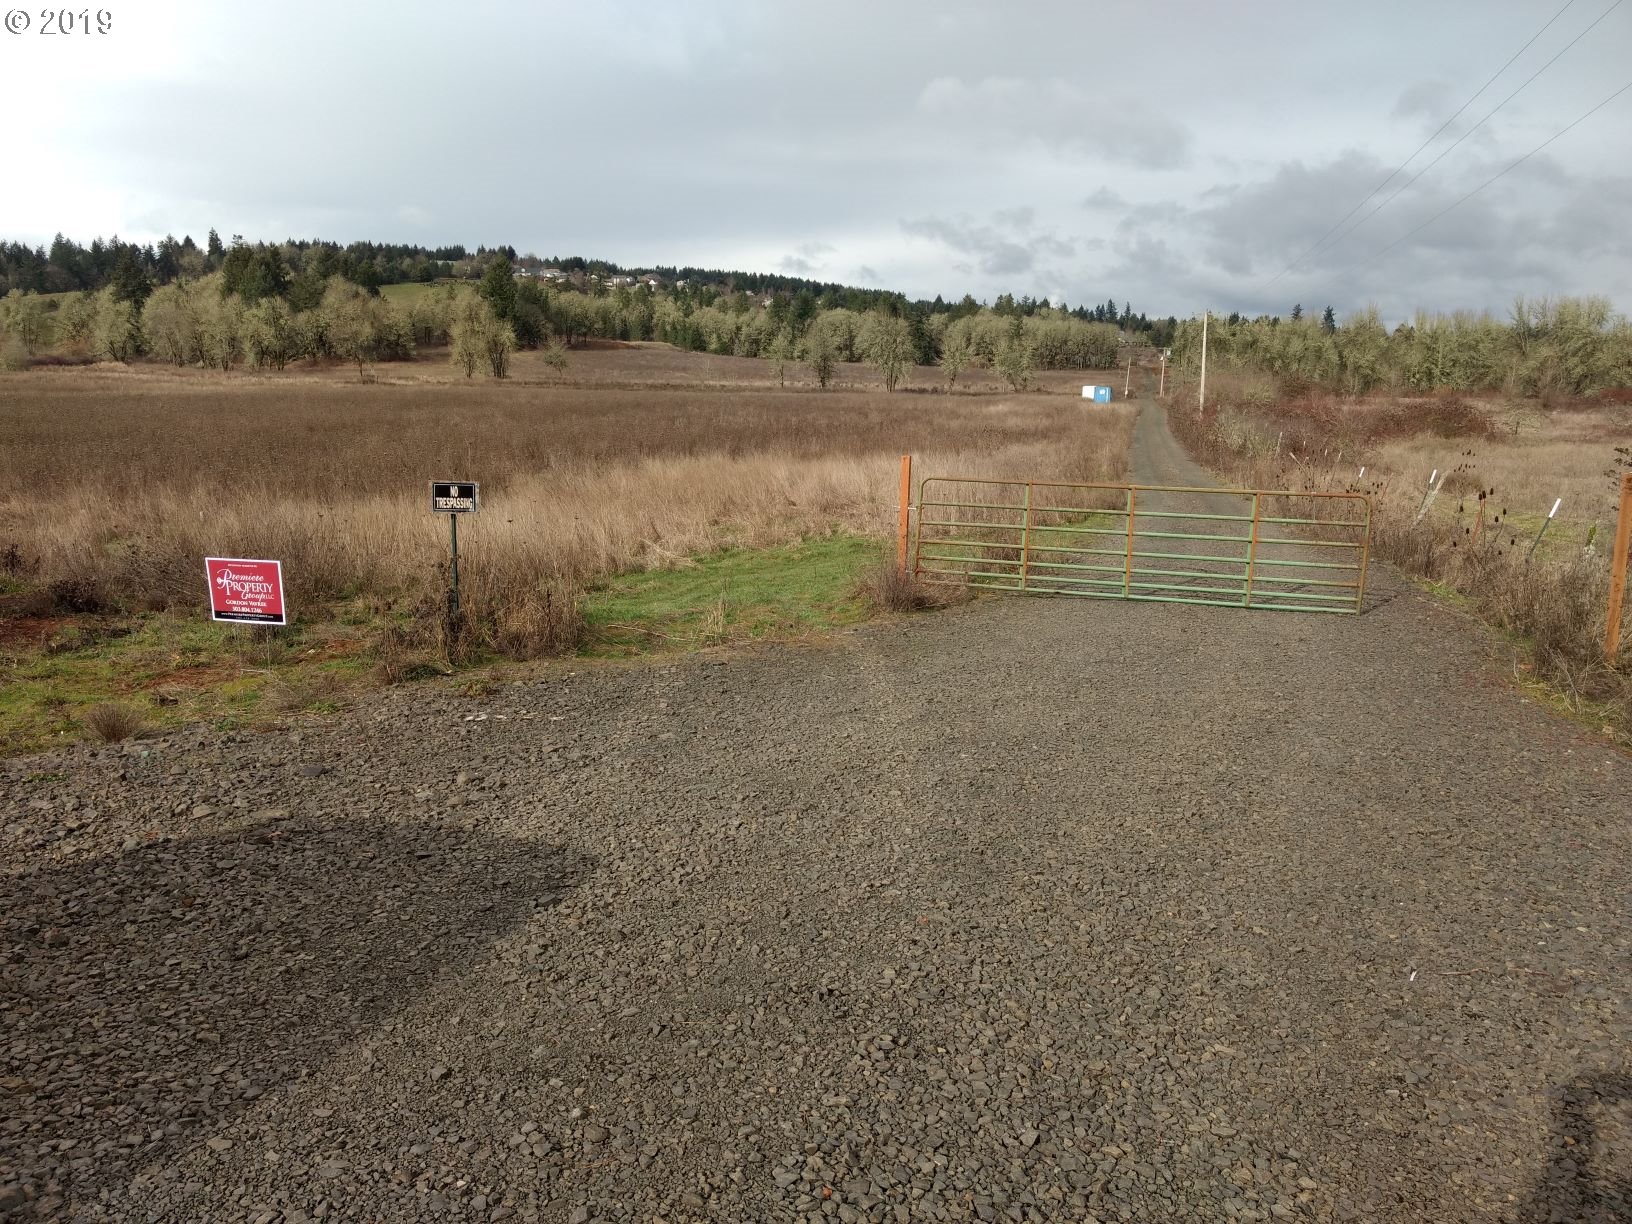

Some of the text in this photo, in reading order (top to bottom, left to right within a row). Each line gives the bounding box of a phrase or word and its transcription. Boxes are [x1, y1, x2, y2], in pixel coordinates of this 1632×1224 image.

[450, 486, 459, 497] NO
[436, 498, 473, 509] TRESPASSING
[217, 568, 264, 587] Premiere
[226, 580, 273, 595] PROPERTY
